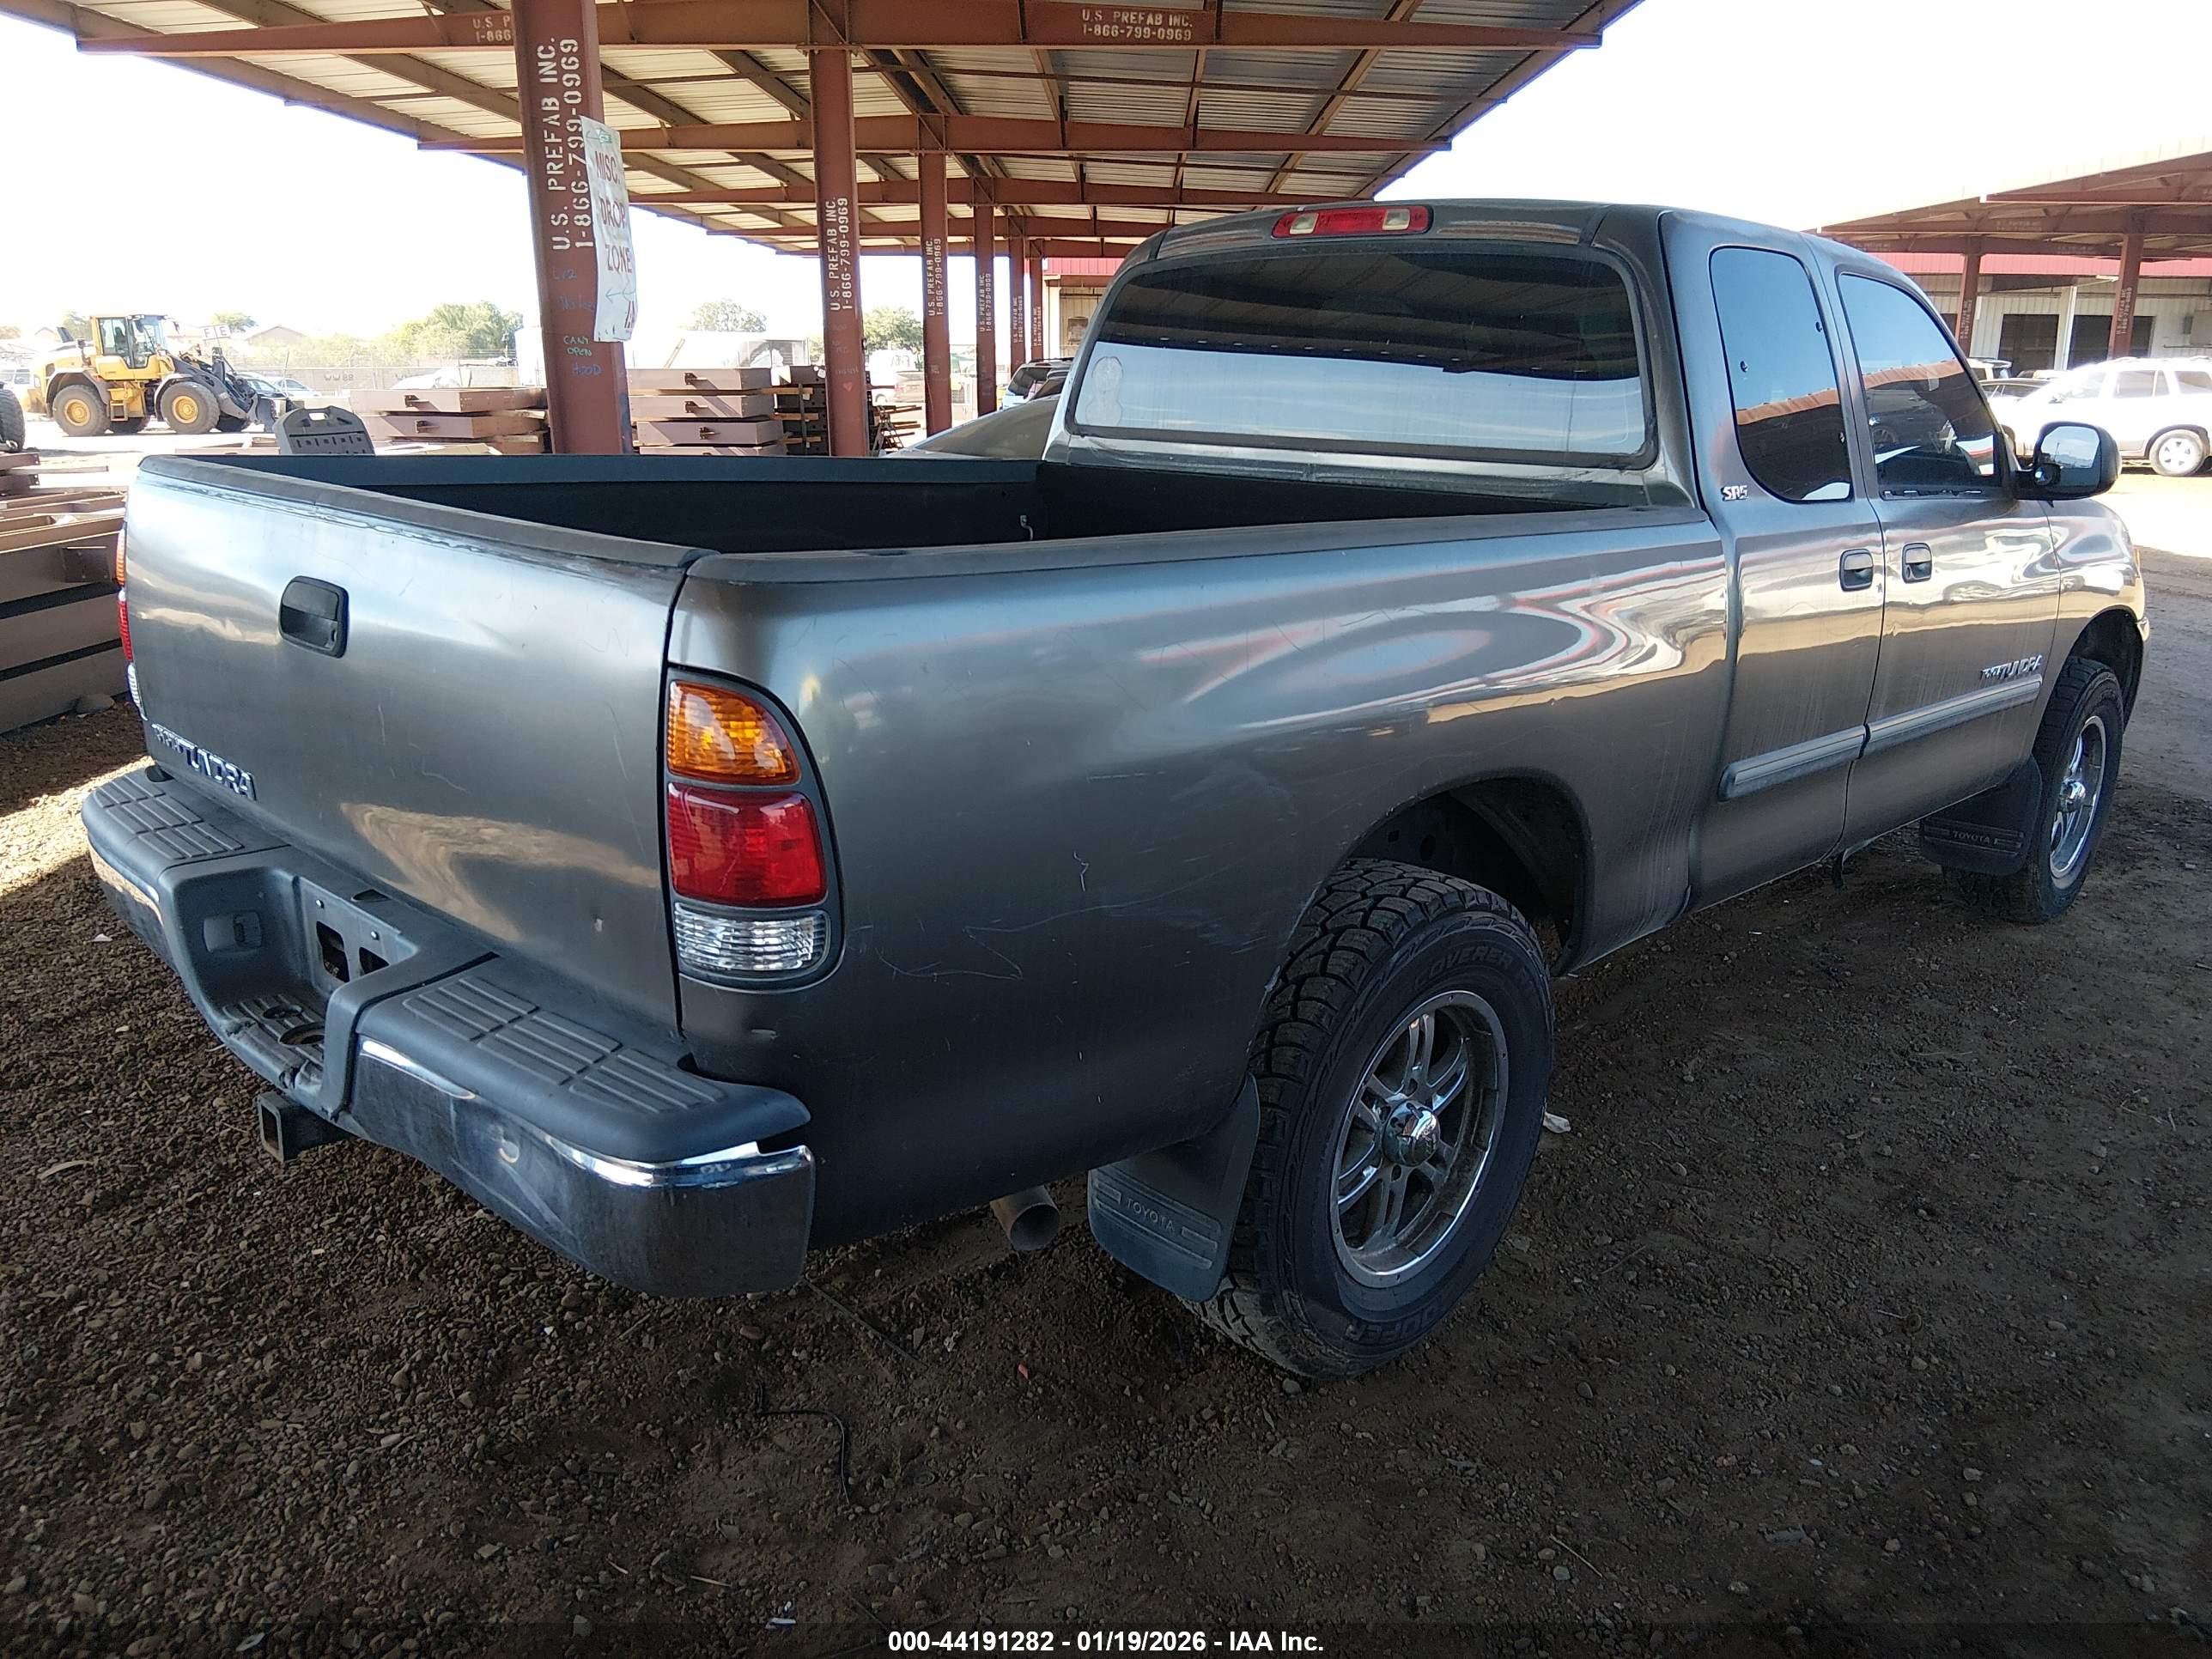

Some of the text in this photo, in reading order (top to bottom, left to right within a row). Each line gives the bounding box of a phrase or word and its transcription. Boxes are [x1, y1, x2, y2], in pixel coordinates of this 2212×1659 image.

[1083, 23, 1192, 41] 1-866-799-0969
[1113, 11, 1164, 26] PREFAB
[1169, 15, 1194, 27] INC.
[537, 37, 558, 83] INC.
[541, 97, 567, 191] PREFAB
[560, 39, 594, 247] 1-866-799-0969
[825, 197, 837, 222] INC.
[550, 206, 571, 250] U.S.
[605, 244, 633, 274] ZONE
[827, 228, 840, 279] PREFAB
[837, 198, 853, 309] 1-866-799-0969
[830, 286, 842, 311] U.S.
[1952, 830, 1990, 844] TOYOTA
[1127, 1198, 1176, 1232] TOYOTA
